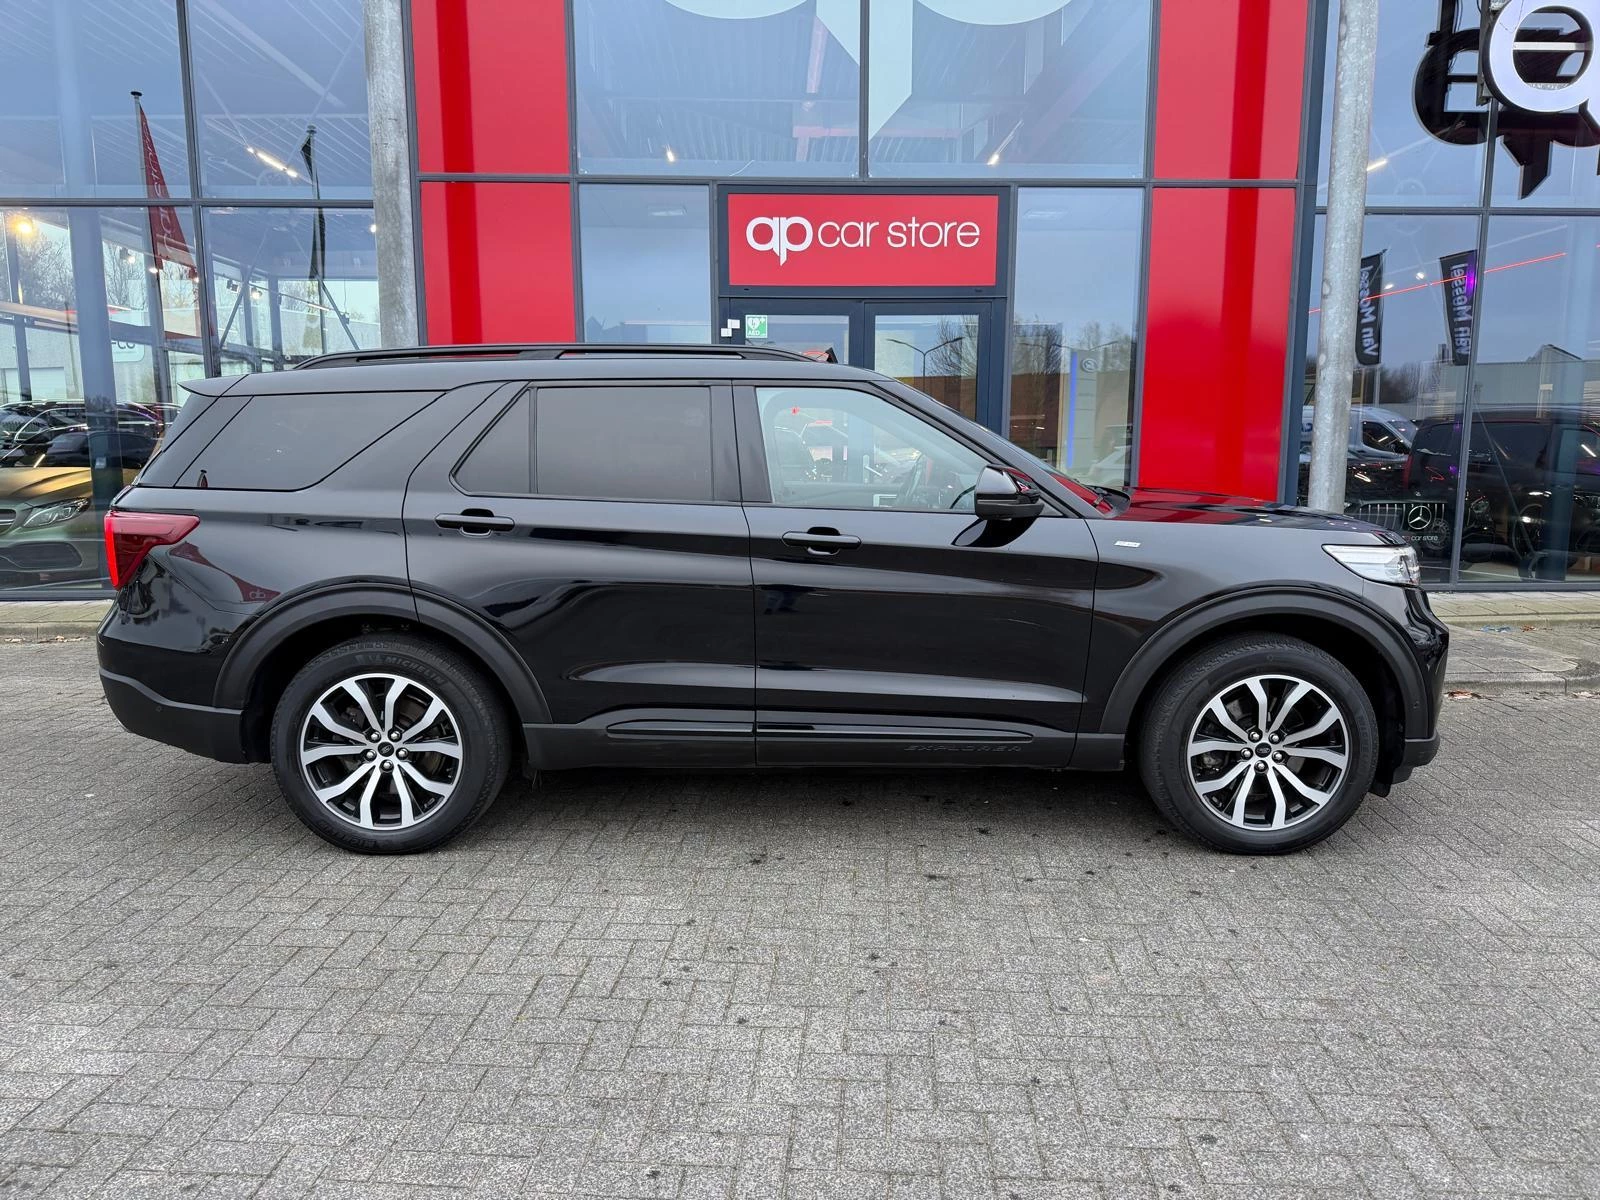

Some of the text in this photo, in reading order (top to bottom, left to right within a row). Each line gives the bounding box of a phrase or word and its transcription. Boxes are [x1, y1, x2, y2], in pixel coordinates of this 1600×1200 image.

[818, 221, 879, 248] car
[887, 216, 980, 248] store
[384, 655, 446, 685] MICHELIN
